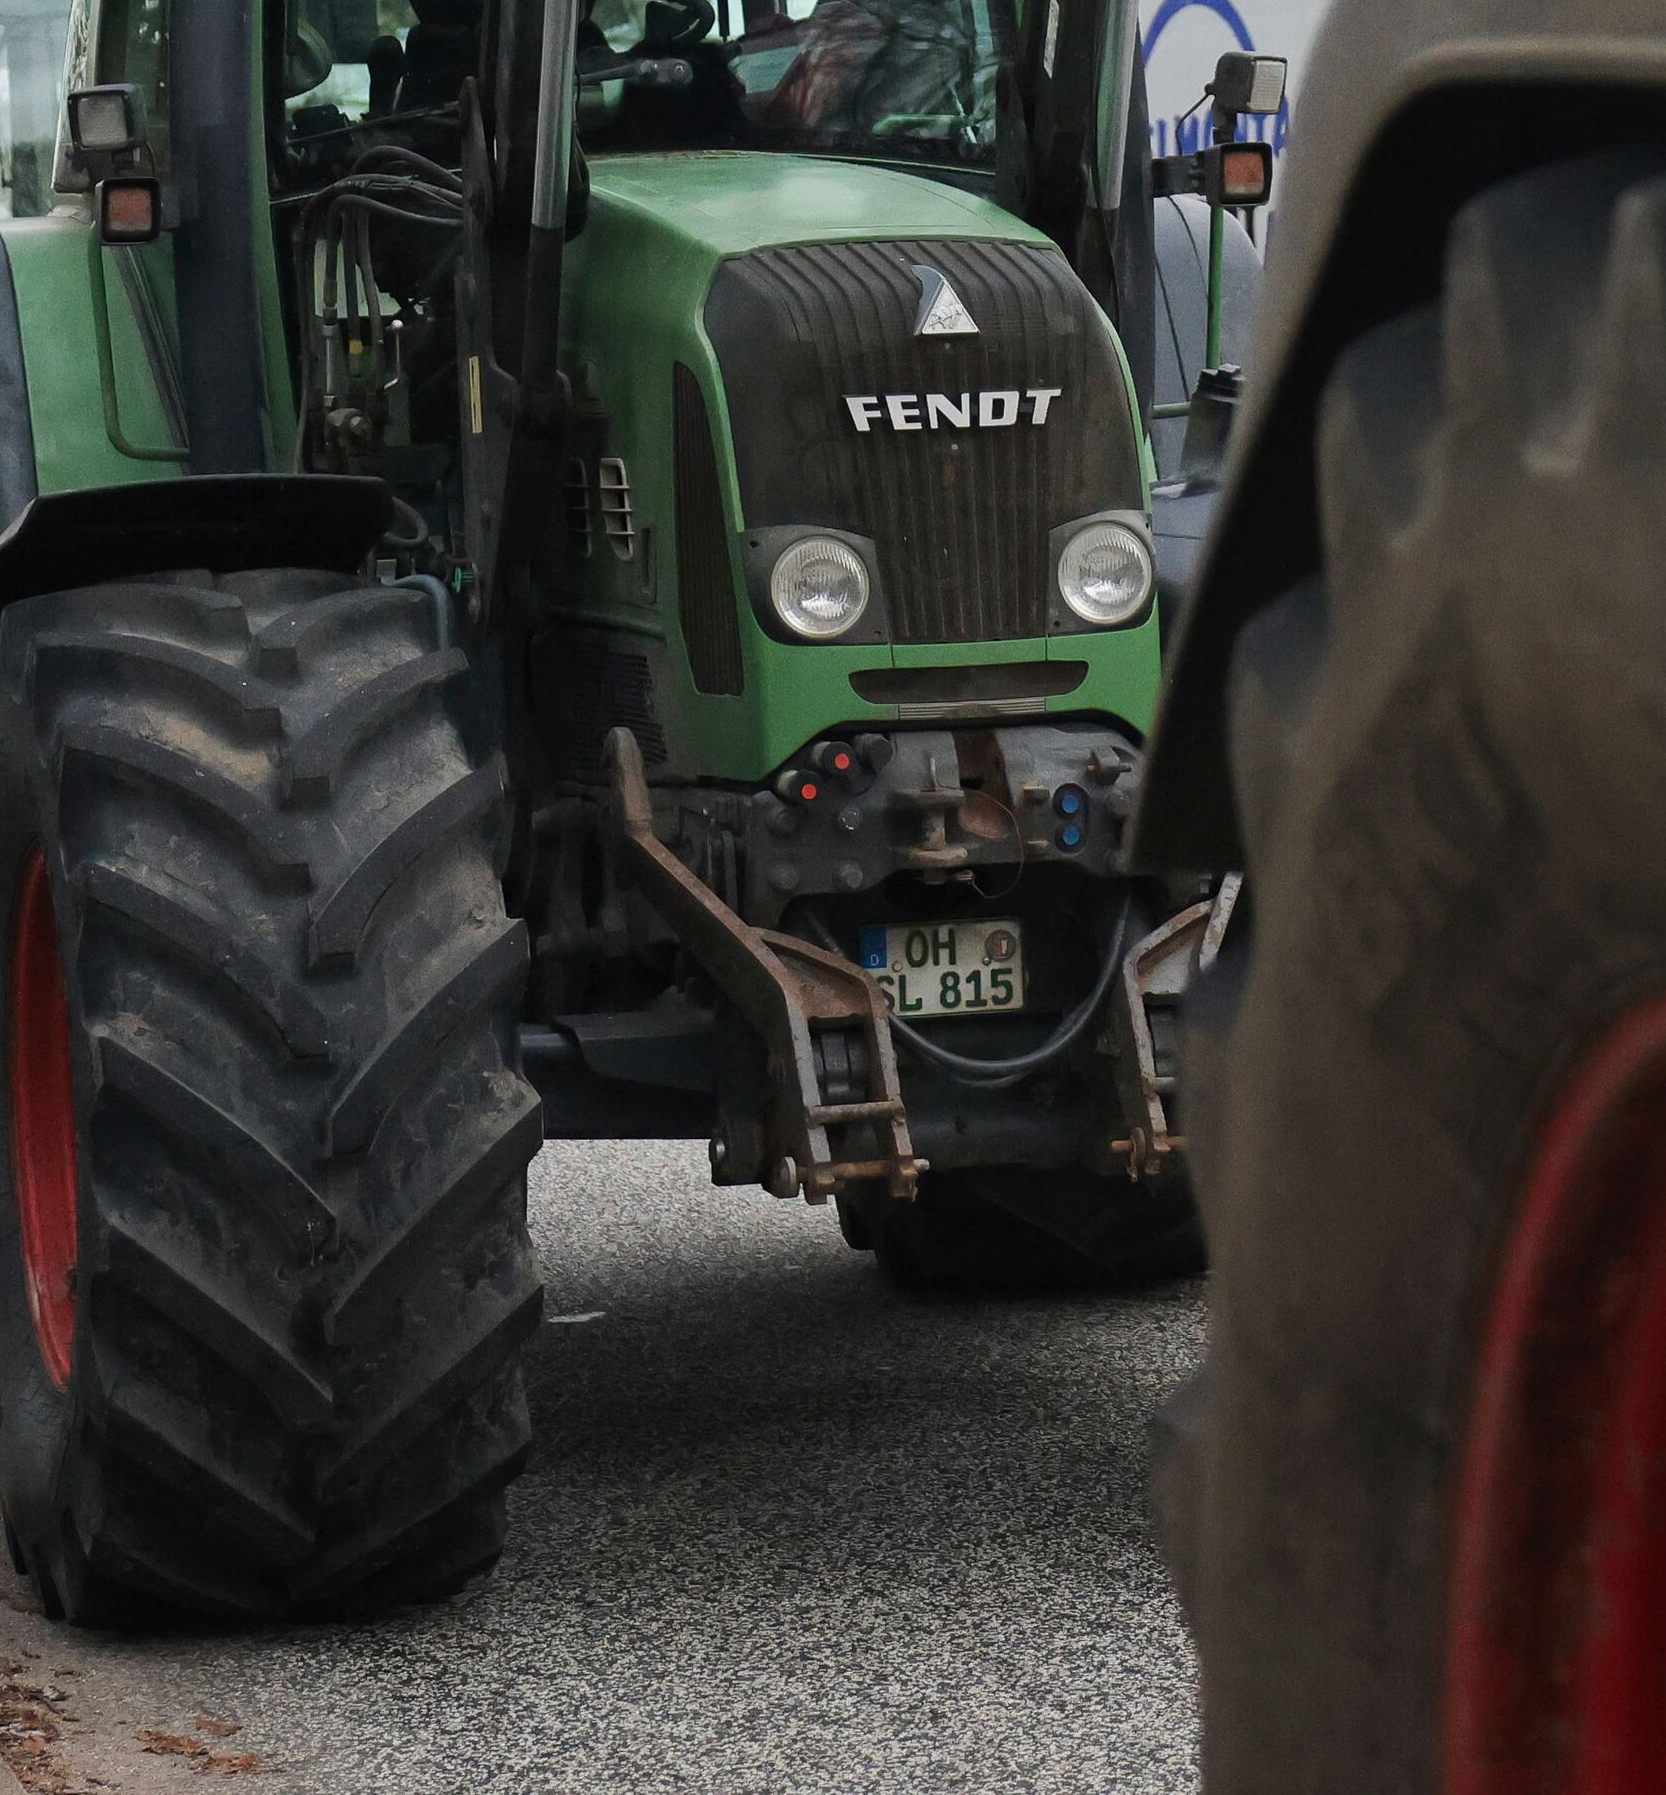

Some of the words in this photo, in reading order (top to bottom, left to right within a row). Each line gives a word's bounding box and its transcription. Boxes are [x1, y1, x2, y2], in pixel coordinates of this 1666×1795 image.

[844, 387, 1062, 432] FENDT
[870, 954, 879, 966] D
[905, 928, 957, 968] OH
[939, 967, 1014, 1009] 815
